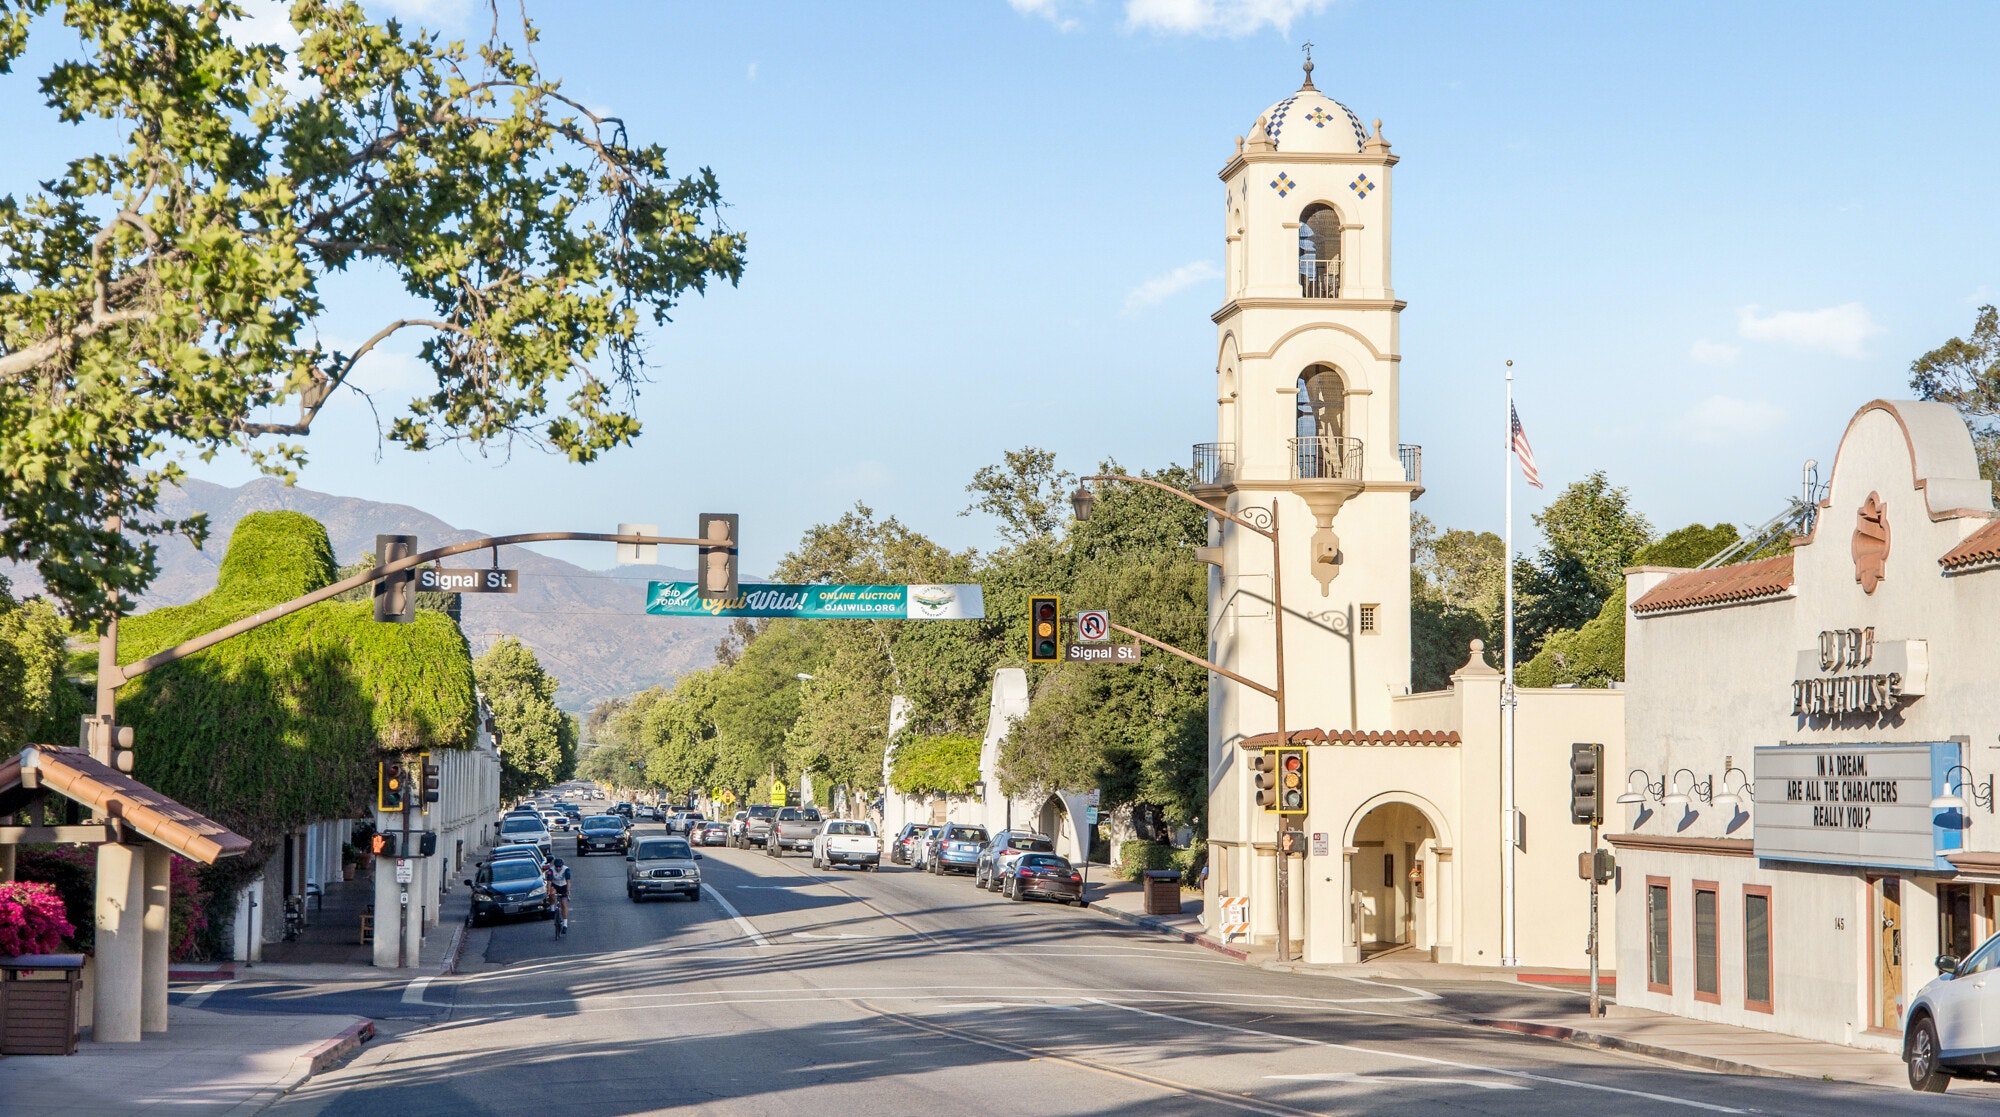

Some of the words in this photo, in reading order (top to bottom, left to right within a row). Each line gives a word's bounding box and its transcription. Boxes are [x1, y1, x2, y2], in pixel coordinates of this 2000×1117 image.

[422, 571, 478, 590] Signal
[487, 572, 512, 588] St.
[656, 598, 689, 606] TODAY!
[819, 592, 856, 600] ONLINE
[858, 592, 901, 600] AUCTION
[824, 604, 896, 612] OJAIWILD.ORG
[1070, 646, 1112, 661] Signal
[1117, 646, 1136, 659] St.
[1818, 626, 1875, 676] OJAI
[1790, 672, 1902, 717] PLAYHOUSE
[1817, 755, 1826, 776] IN
[1828, 755, 1835, 776] A
[1787, 780, 1803, 801] ARE
[1805, 781, 1821, 801] ALL
[1823, 781, 1839, 802] THE
[1841, 781, 1898, 803] CHARACTERS
[1813, 806, 1844, 827] REALLY
[1847, 807, 1871, 829] YOU?
[1834, 917, 1845, 930] 145
